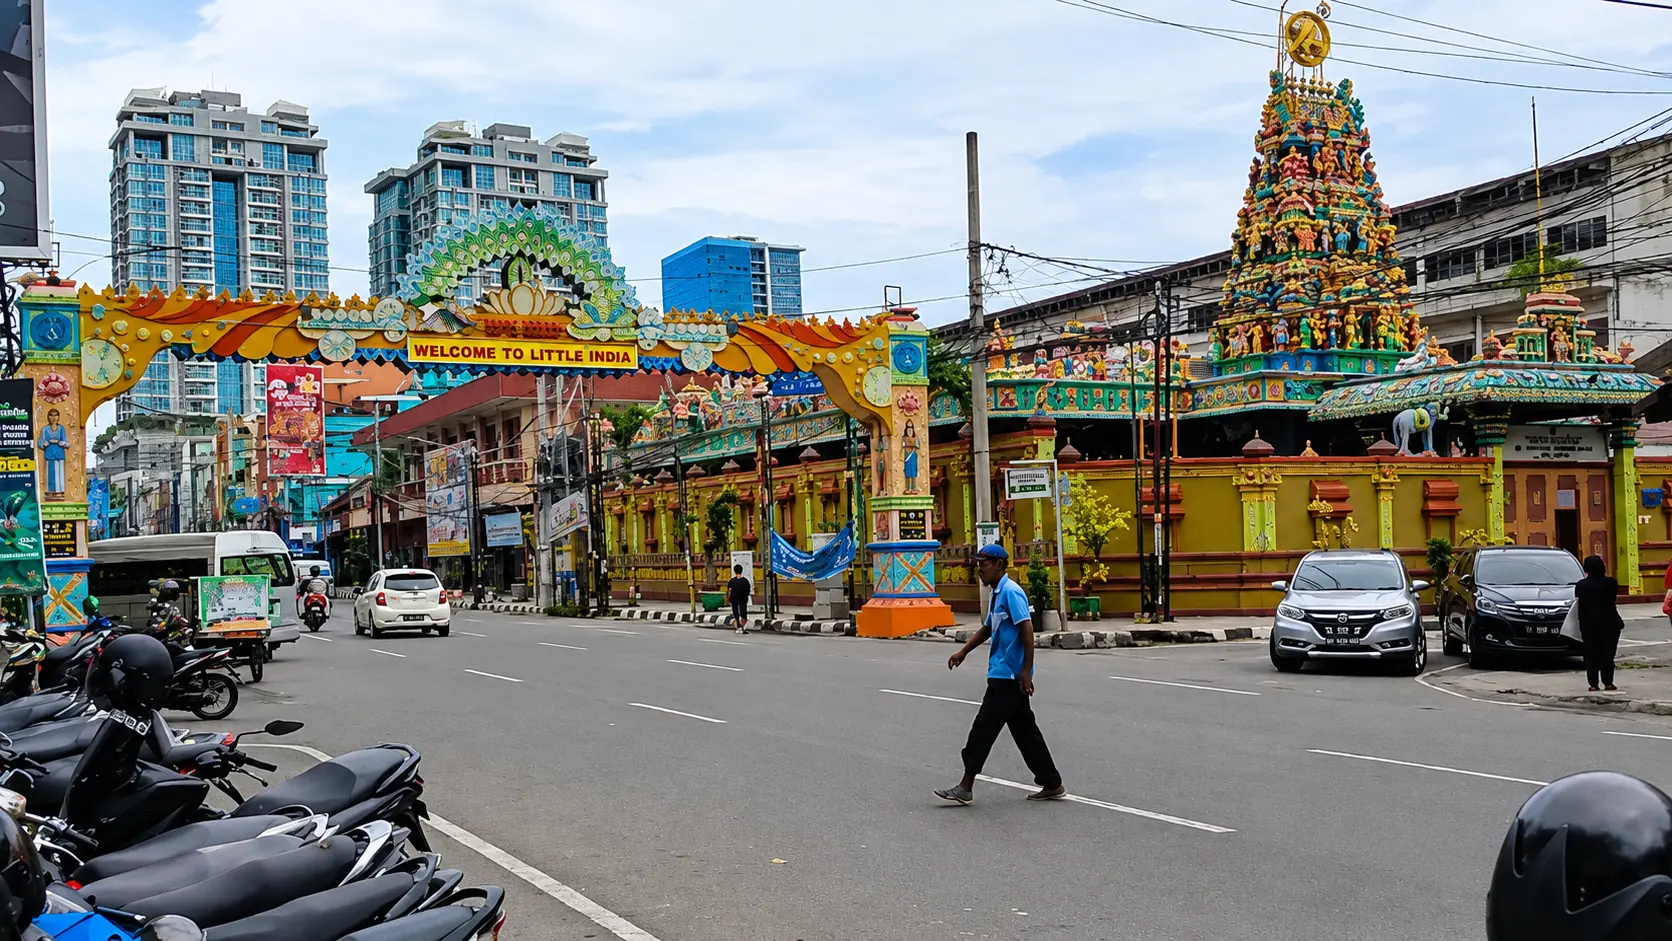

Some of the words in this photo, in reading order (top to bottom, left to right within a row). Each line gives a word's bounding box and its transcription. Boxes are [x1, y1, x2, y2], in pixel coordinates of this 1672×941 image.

[414, 344, 496, 359] WELCOME
[502, 347, 524, 360] TO
[531, 348, 584, 362] LITTLE
[589, 350, 632, 363] INDIA
